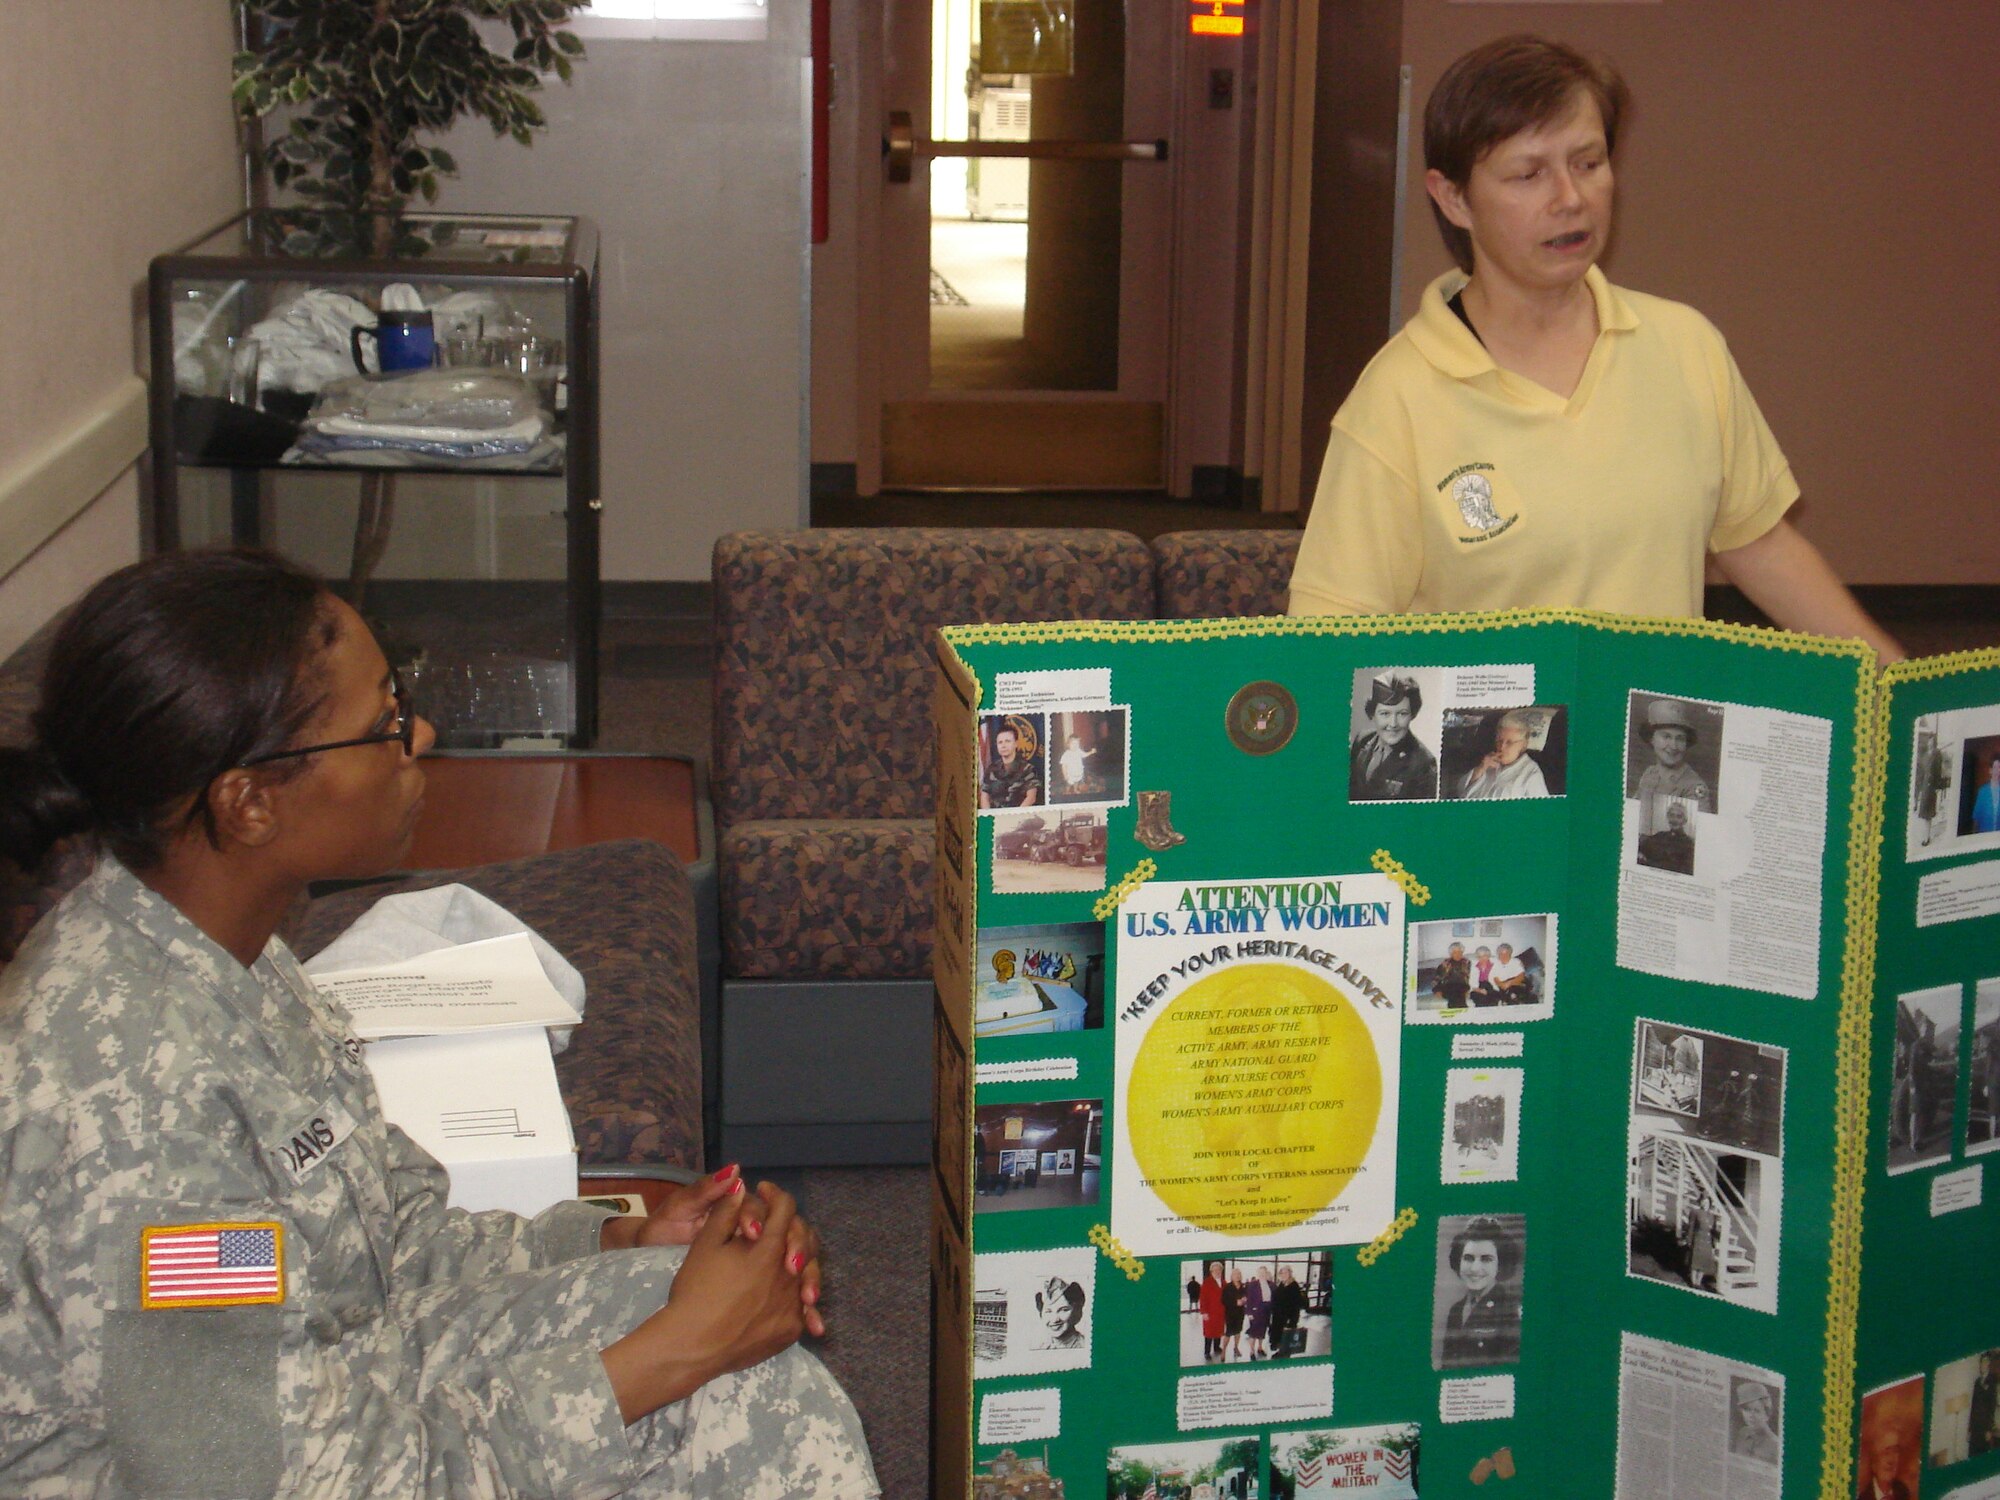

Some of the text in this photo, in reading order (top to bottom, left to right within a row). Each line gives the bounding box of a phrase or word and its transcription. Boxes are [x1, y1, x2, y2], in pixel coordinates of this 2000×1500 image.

[1176, 881, 1342, 911] ATTENTION
[1126, 902, 1391, 937] U.S. ARMY WOMEN
[1120, 939, 1394, 1022] "KEEP YOUR HERITAGE ALIVE"
[1171, 1004, 1339, 1021] CURRENT, FORMER OR RETIRED
[1208, 1022, 1302, 1035] MEMBERS OF THE
[1176, 1043, 1215, 1054] ACTIVE
[1250, 1039, 1282, 1050] ARMY
[1283, 1036, 1332, 1048] RESERVE
[1190, 1053, 1317, 1069] ARMY NATIONAL GUARD
[1200, 1070, 1306, 1085] ARMY NURSE CORPS
[1194, 1085, 1313, 1100] WOMEN'S ARMY CORPS
[1161, 1107, 1211, 1119] WOMEN'S
[1212, 1106, 1243, 1117] ARMY
[1309, 1100, 1345, 1110] CORPS
[1193, 1145, 1315, 1159] JOIN YOUR LOCAL CHAPTER
[1248, 1160, 1260, 1168] OF
[1139, 1165, 1368, 1187] THE WOMEN'S ARMY CORPS VETERANS ASSOCIATION
[1239, 1198, 1259, 1206] Keep
[1176, 1226, 1192, 1234] call:
[1326, 1448, 1384, 1466] WOMEN IN
[1344, 1463, 1365, 1475] THE
[1331, 1474, 1380, 1488] MILITARY
